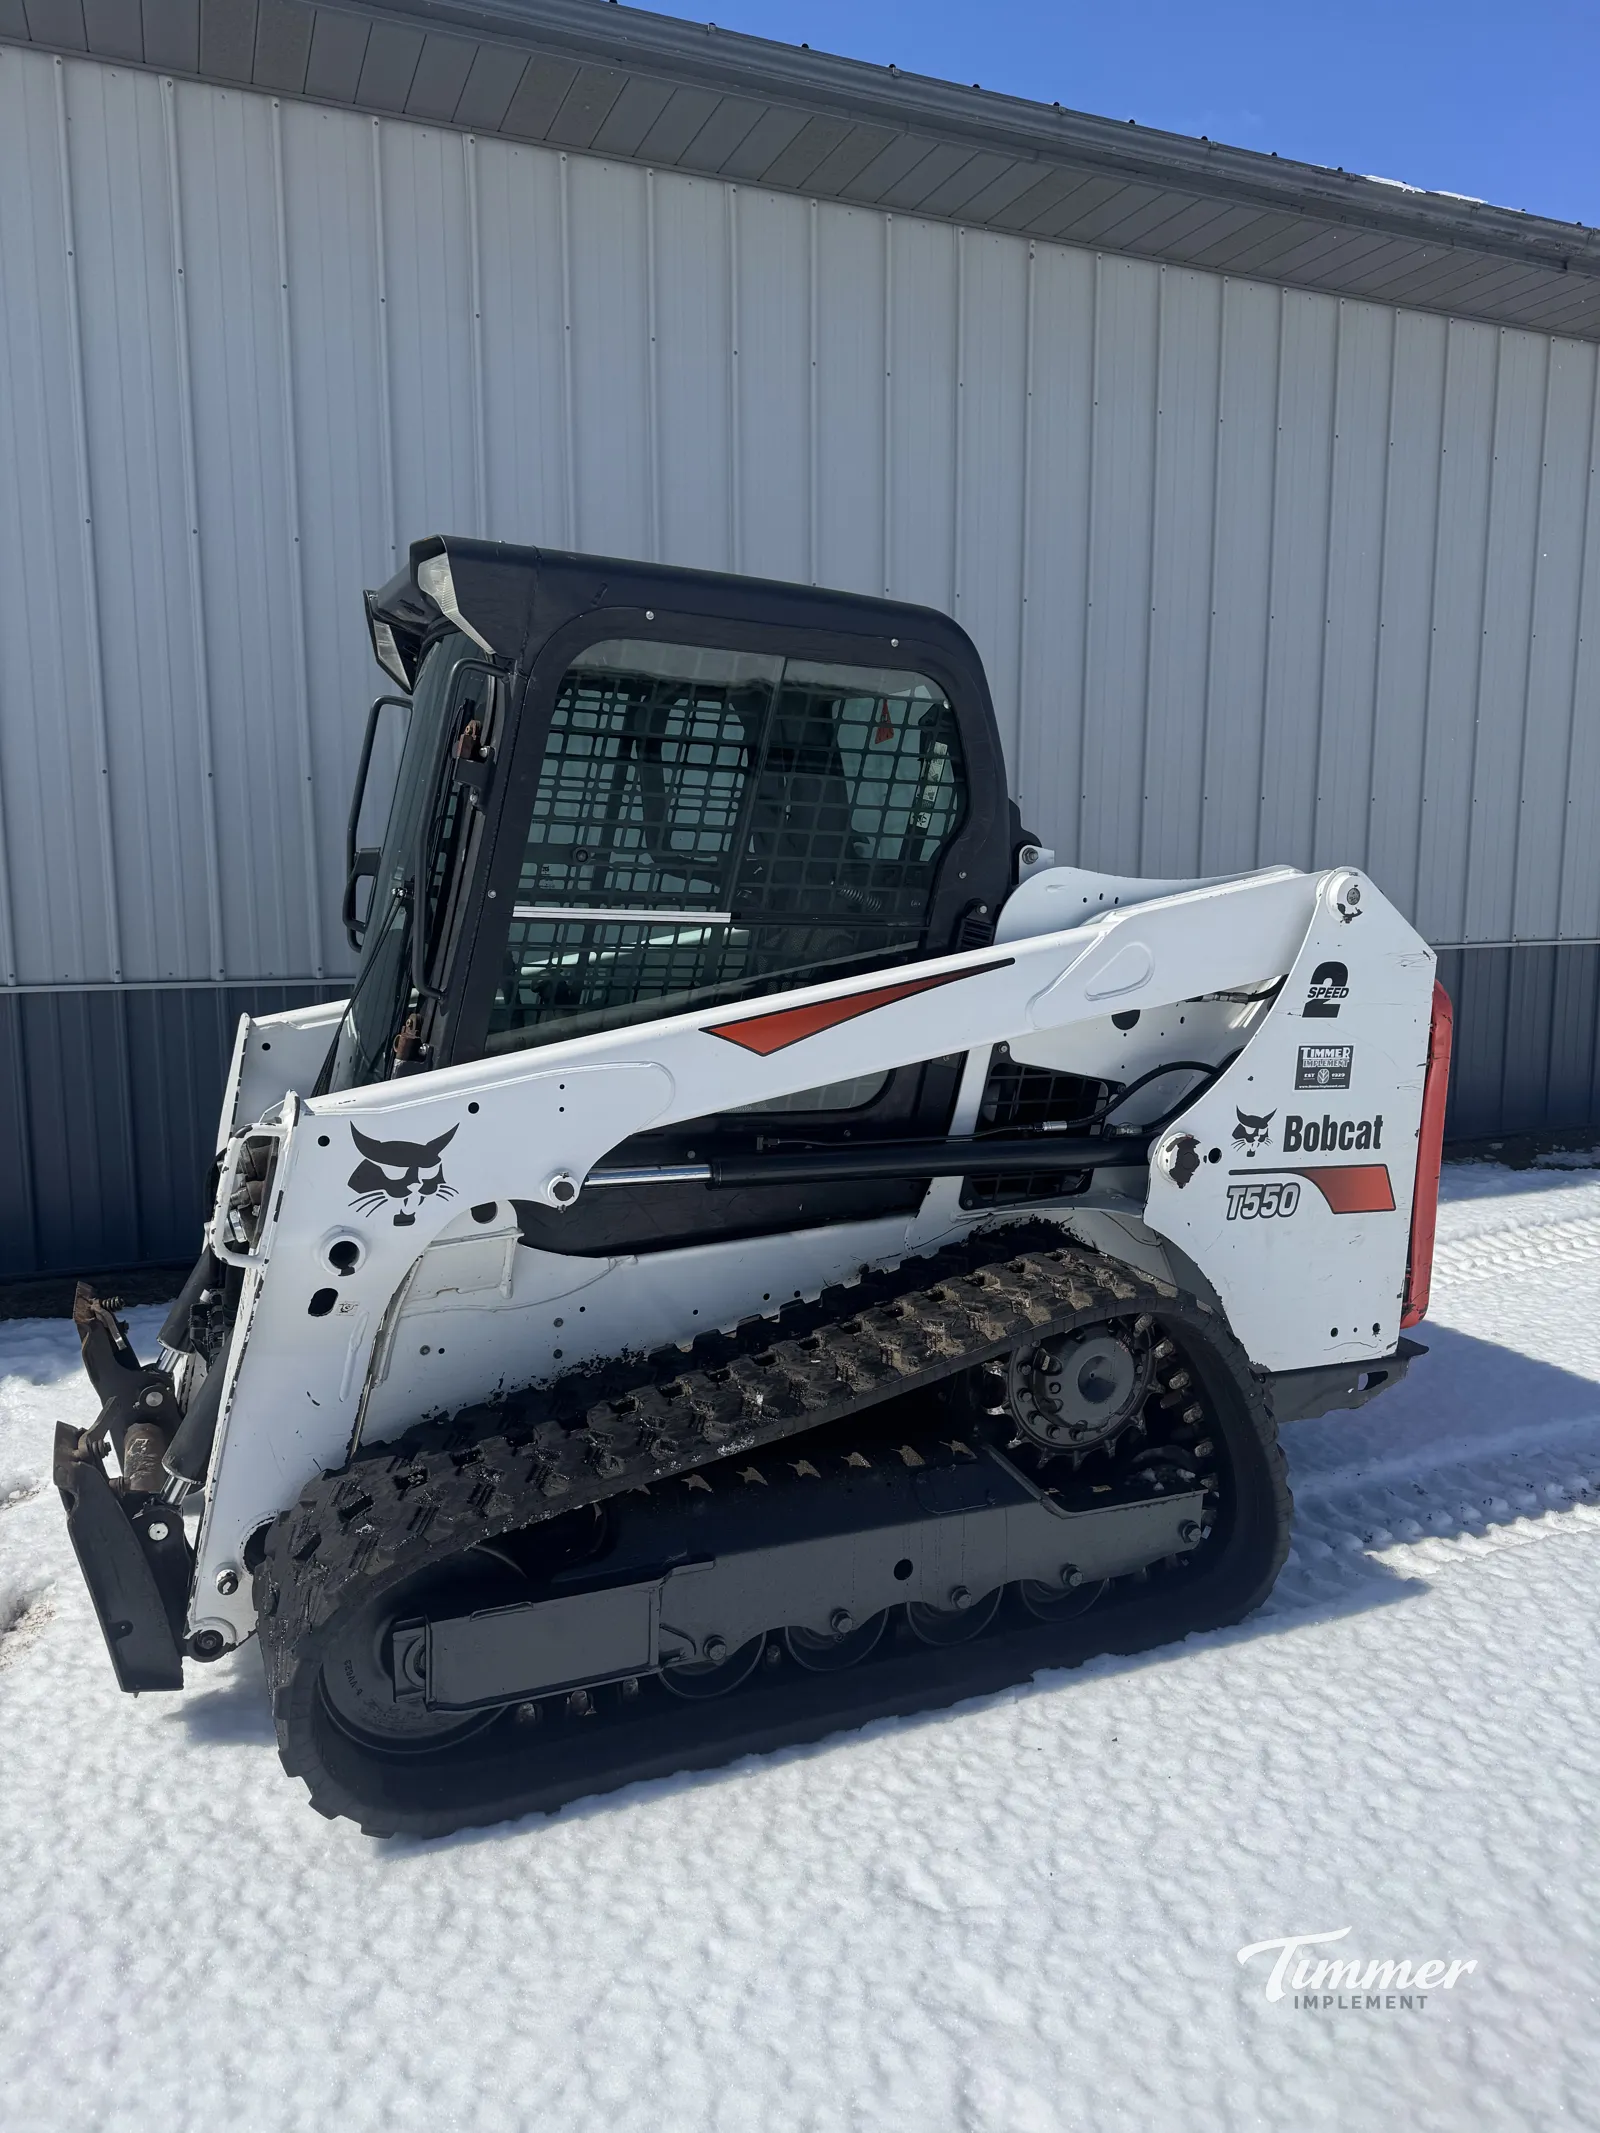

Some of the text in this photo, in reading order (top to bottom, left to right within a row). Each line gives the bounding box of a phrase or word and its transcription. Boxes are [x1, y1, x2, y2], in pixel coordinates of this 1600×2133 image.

[1302, 961, 1349, 1018] 2
[1307, 986, 1350, 999] SPEED
[1300, 1046, 1351, 1060] TIMMER
[1302, 1059, 1350, 1068] IMPLEMENT
[1282, 1114, 1384, 1153] Bobcat
[1226, 1181, 1301, 1221] T550
